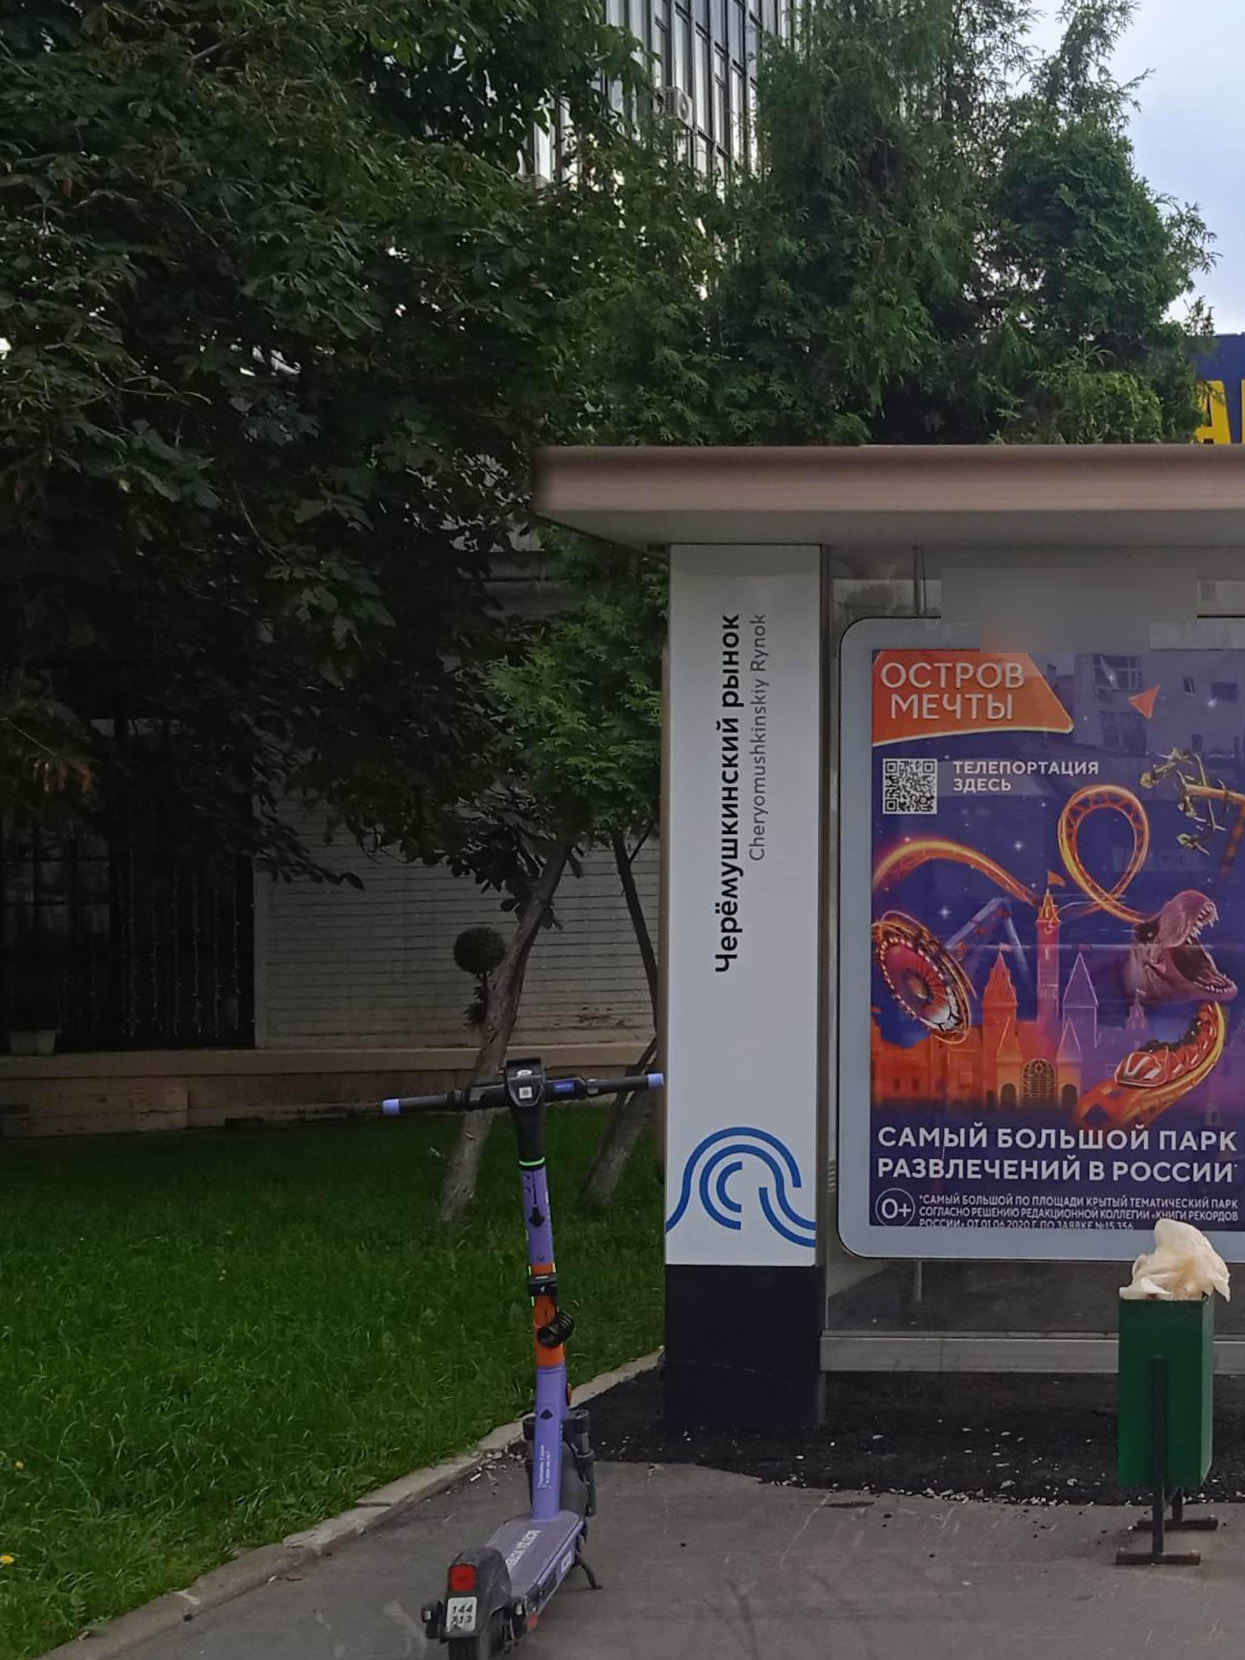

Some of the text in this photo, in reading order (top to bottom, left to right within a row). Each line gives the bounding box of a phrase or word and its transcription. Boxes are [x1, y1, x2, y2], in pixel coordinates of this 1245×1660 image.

[880, 662, 1025, 689] ОСТРОВ
[890, 693, 1013, 720] МЕЧТЫ
[749, 613, 769, 861] Cheryomushkinskiy Rynok
[952, 760, 1099, 776] ТЕЛЕПОРТАЦИЯ
[715, 614, 745, 972] Черёмушкинский рынок
[952, 778, 1012, 793] ЗДЕСЬ
[878, 1122, 1238, 1151] САМЫЙ БОЛЬШОЙ ПАРК
[878, 1155, 1080, 1180] РАЗВЛЕЧЕНИЙ
[1089, 1161, 1105, 1181] В
[881, 1198, 911, 1219] 0+
[962, 1193, 1013, 1205] БОЛЬШОЙ
[1015, 1196, 1030, 1206] ПО
[1032, 1196, 1083, 1208] ПЛОЩАДИ
[1086, 1195, 1128, 1207] КРЫТЫЙ
[1130, 1196, 1209, 1208] ТЕМАТИЧЕСКИЙ
[1211, 1198, 1238, 1209] ПАРК
[919, 1207, 970, 1217] СОГЛАСНО
[971, 1208, 1019, 1217] РЕШЕНИЮ
[1021, 1207, 1099, 1219] РЕДАКЦИОННОЙ
[1100, 1209, 1150, 1220] КОЛЛЕГИИ
[1188, 1211, 1238, 1222] РЕКОРДОВ
